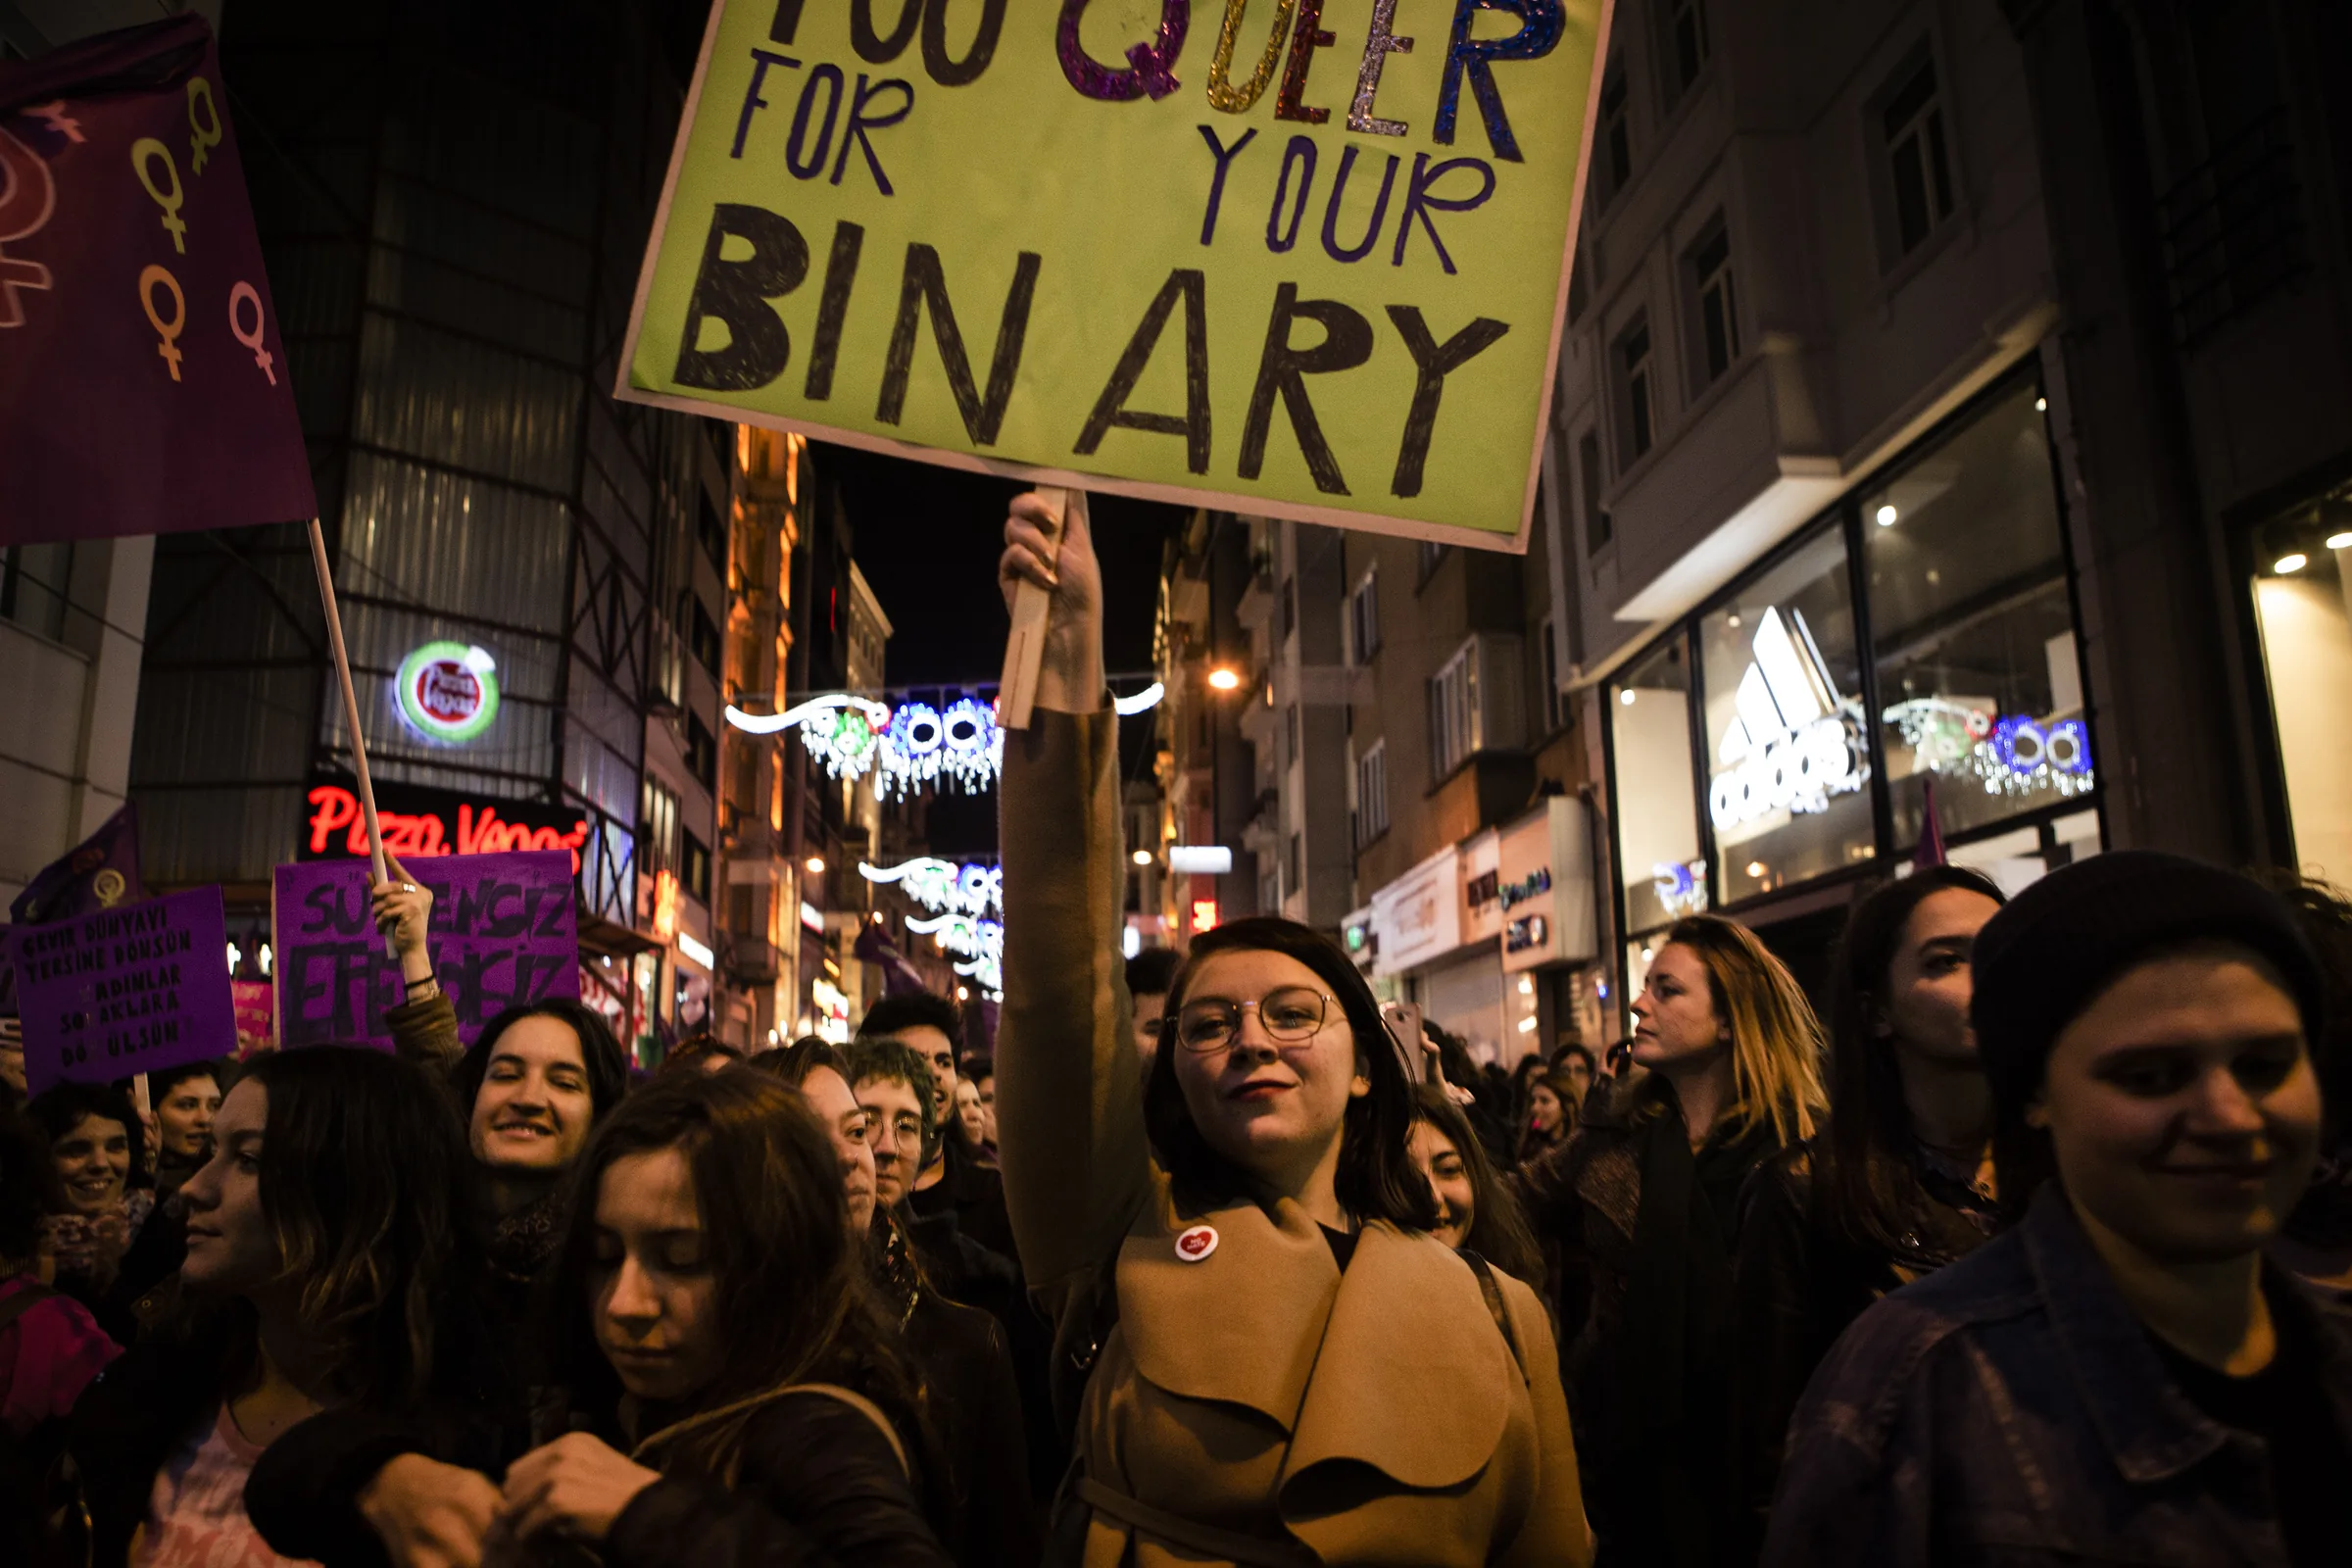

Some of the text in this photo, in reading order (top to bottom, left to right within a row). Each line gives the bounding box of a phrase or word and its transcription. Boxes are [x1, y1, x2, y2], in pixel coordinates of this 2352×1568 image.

[730, 48, 1495, 275] FOR YOUR
[1055, 0, 1566, 164] QUEER
[671, 203, 1511, 498] BINARY
